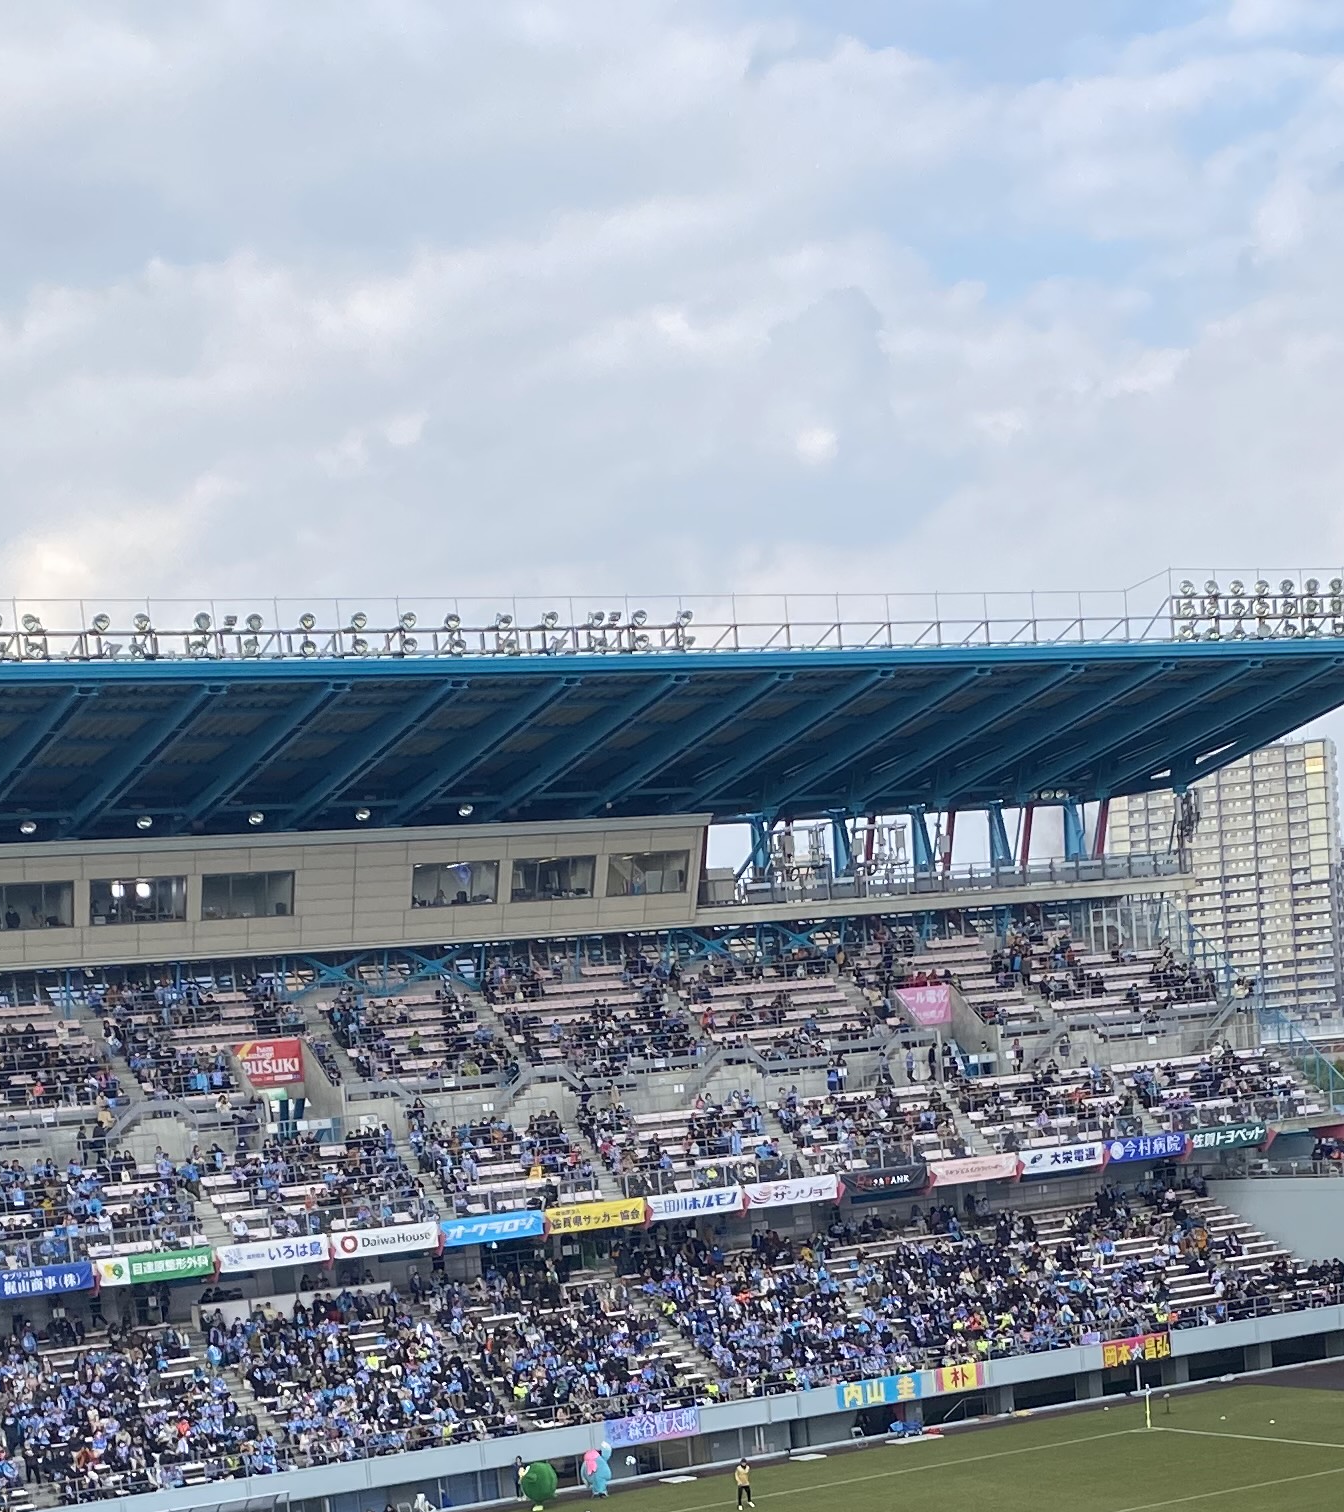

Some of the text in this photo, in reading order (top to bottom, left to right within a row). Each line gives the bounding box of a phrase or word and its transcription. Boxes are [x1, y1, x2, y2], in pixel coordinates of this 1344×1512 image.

[1193, 1126, 1265, 1148] 佐賀トヨペット
[1123, 1137, 1181, 1158] 今村病院
[361, 1231, 431, 1248] Daiwa House
[268, 1241, 323, 1261] いろは島
